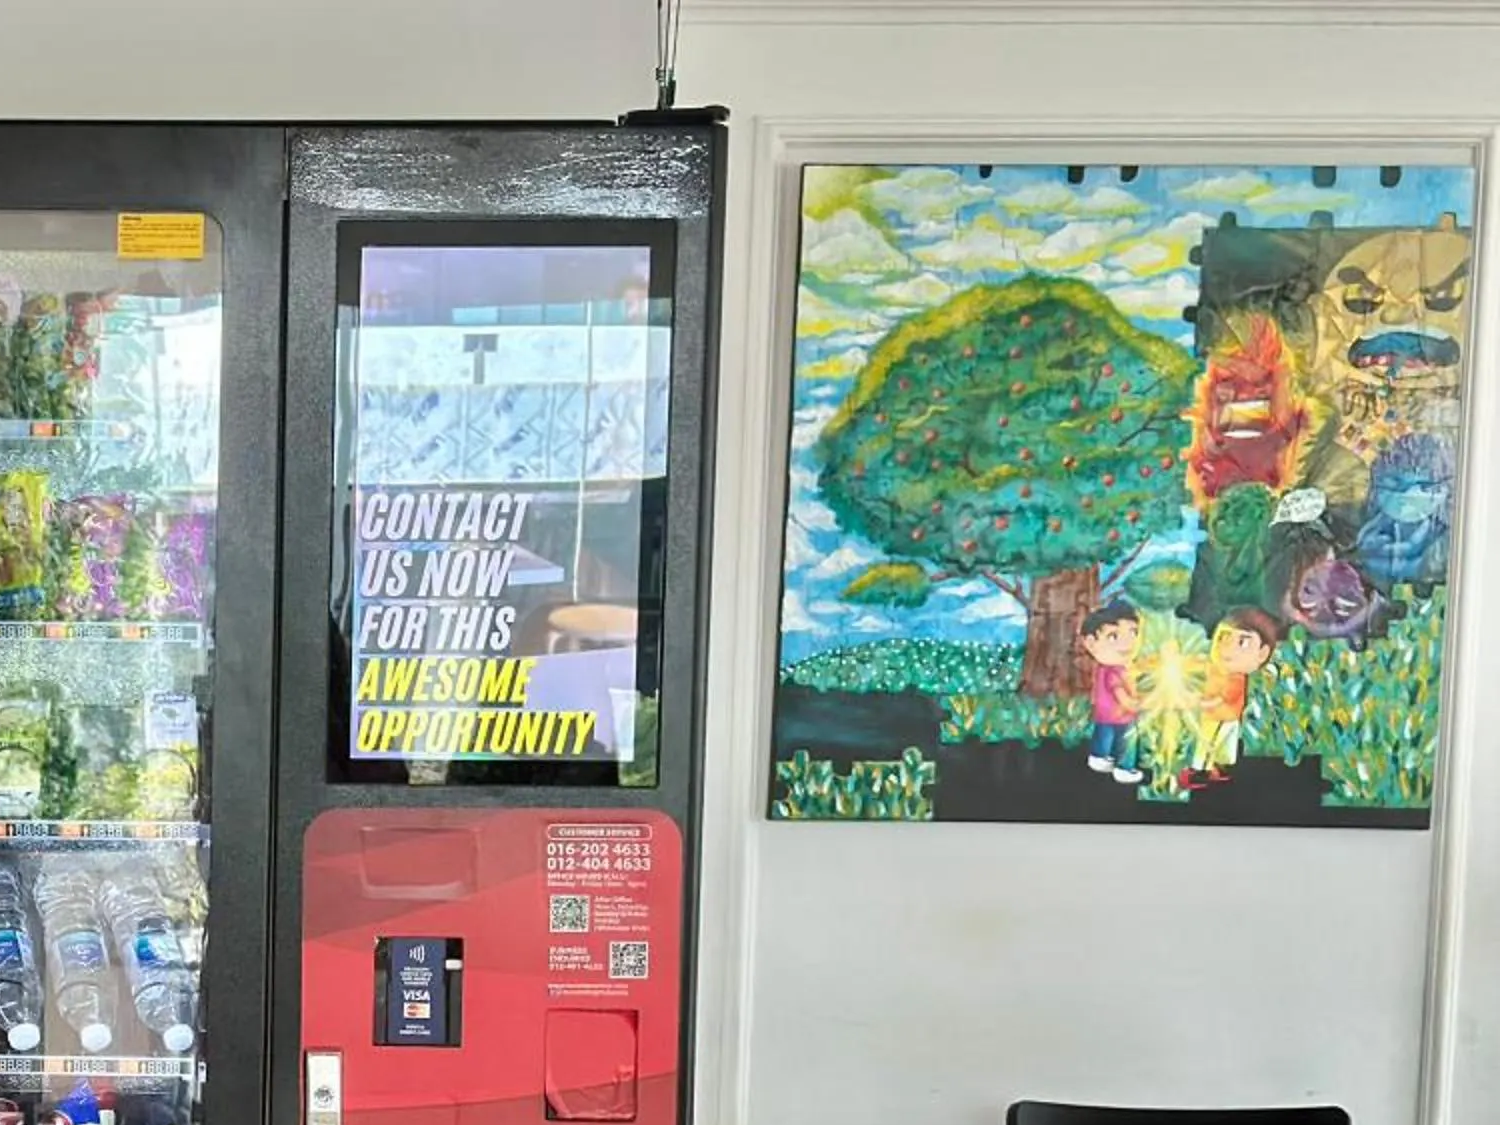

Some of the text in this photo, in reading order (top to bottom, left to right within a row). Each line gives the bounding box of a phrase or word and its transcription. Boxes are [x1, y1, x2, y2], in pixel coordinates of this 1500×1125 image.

[360, 492, 533, 542] CONTACT
[360, 549, 513, 598] US NOW
[359, 604, 516, 651] FOR THIS
[357, 657, 537, 705] AWESOME
[356, 710, 596, 756] OPPORTUNITY
[547, 842, 651, 857] 016-202 4633
[547, 857, 651, 871] 012-404 4633
[403, 989, 430, 1001] VISA
